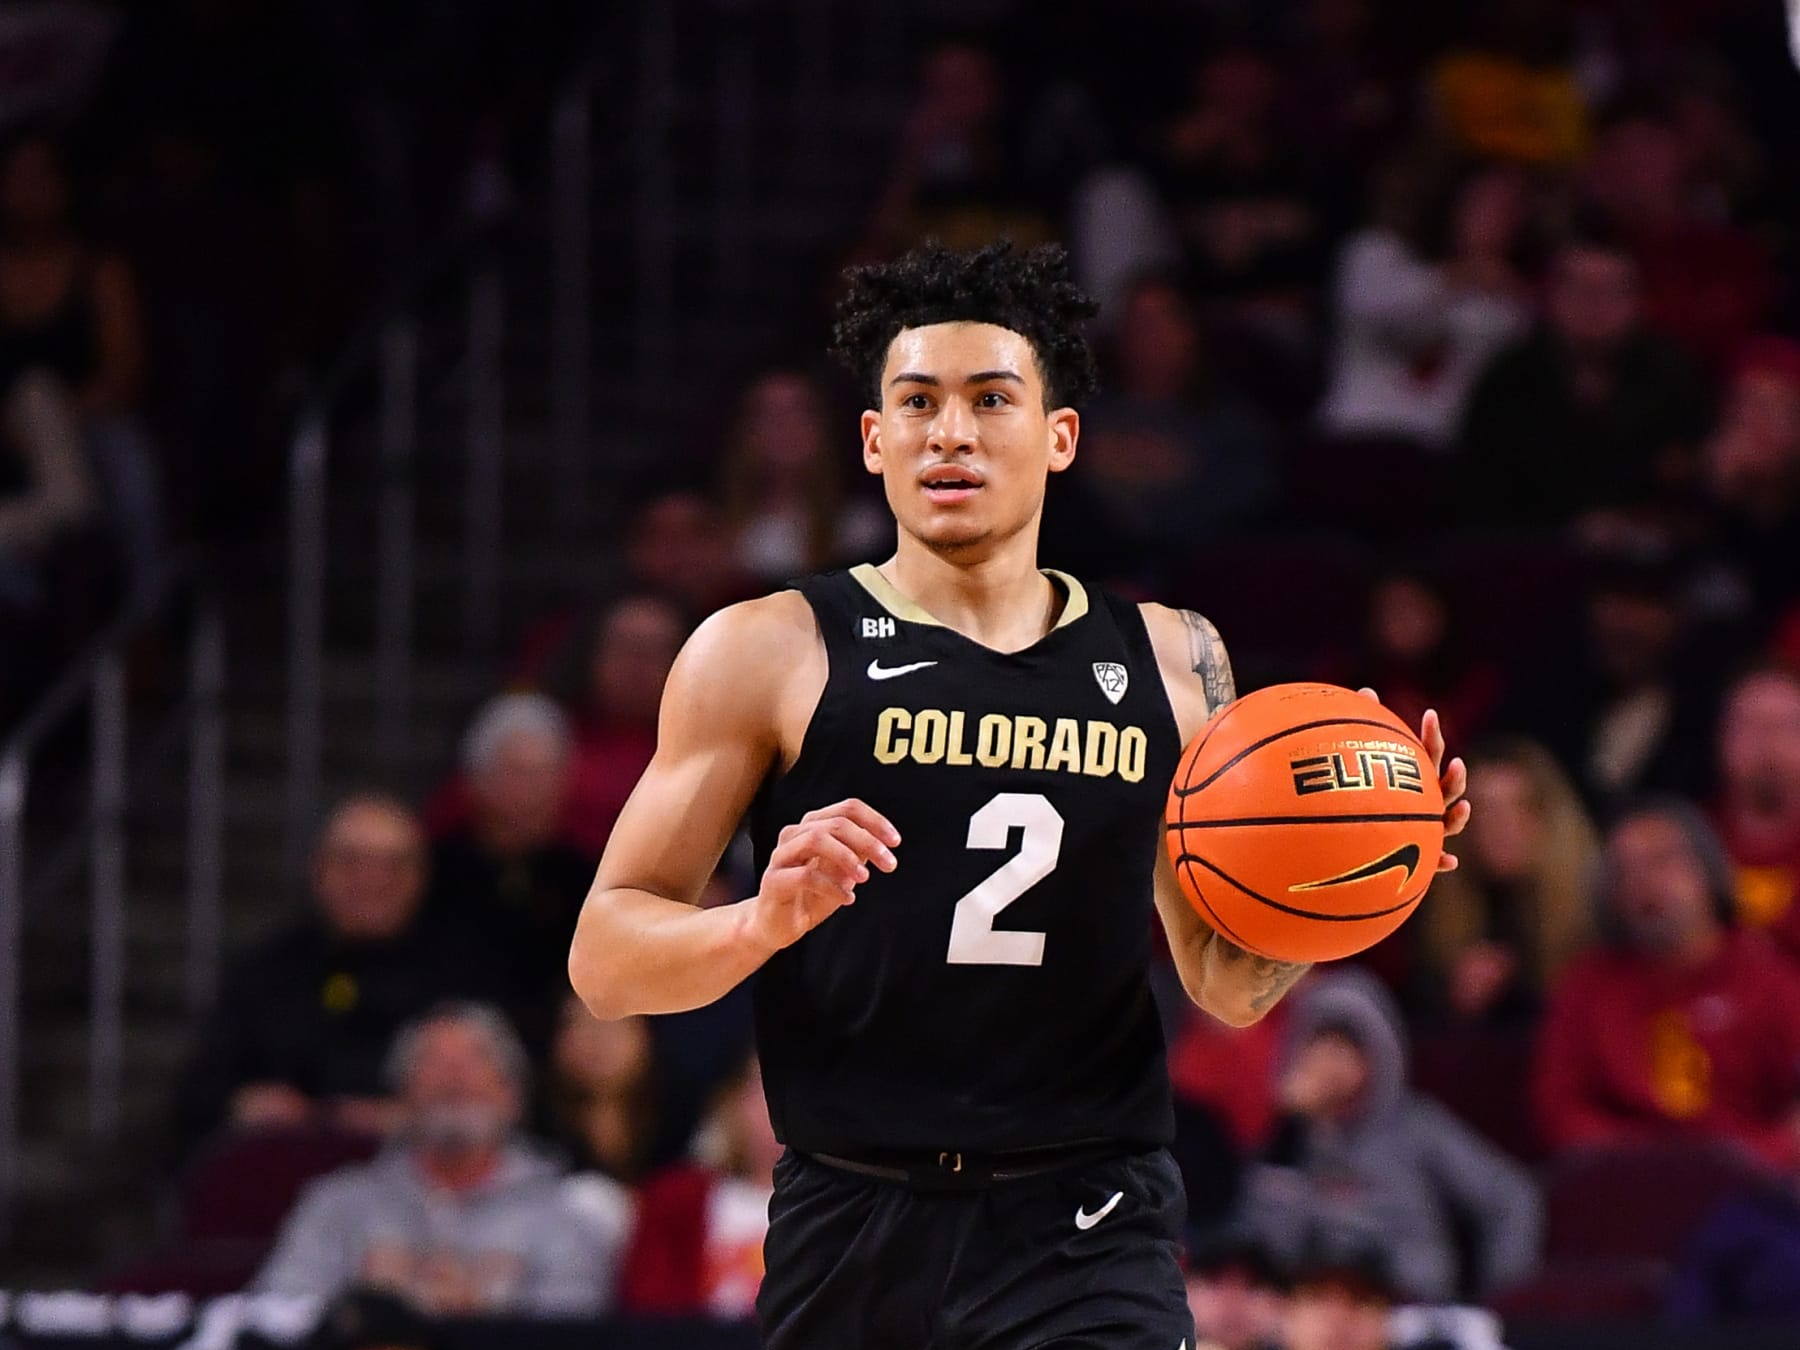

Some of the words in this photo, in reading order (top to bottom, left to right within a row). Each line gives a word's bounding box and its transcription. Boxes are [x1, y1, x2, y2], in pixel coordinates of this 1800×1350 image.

[862, 616, 896, 638] BH
[1105, 678, 1121, 693] 12
[872, 706, 1149, 784] COLORADO
[1289, 750, 1425, 797] ELITE
[945, 791, 1066, 968] 2
